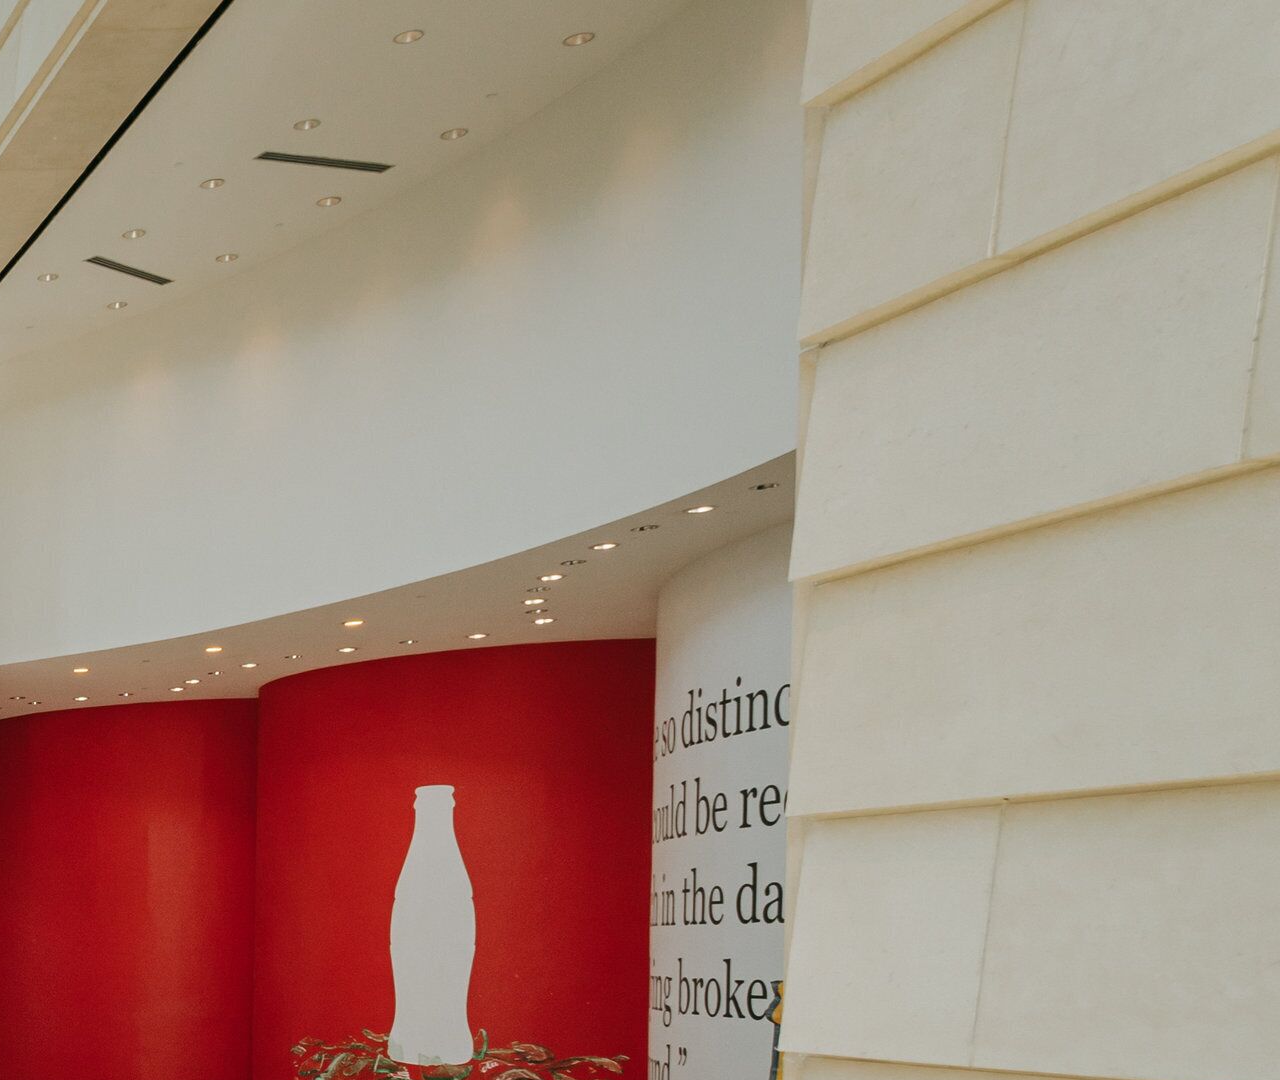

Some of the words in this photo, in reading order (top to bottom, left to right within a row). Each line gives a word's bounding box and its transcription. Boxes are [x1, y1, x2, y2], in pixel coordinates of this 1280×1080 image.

[661, 717, 676, 757] so
[652, 781, 687, 844] ould
[694, 777, 728, 835] be
[739, 785, 788, 829] re
[661, 873, 676, 926] in
[682, 868, 724, 926] the
